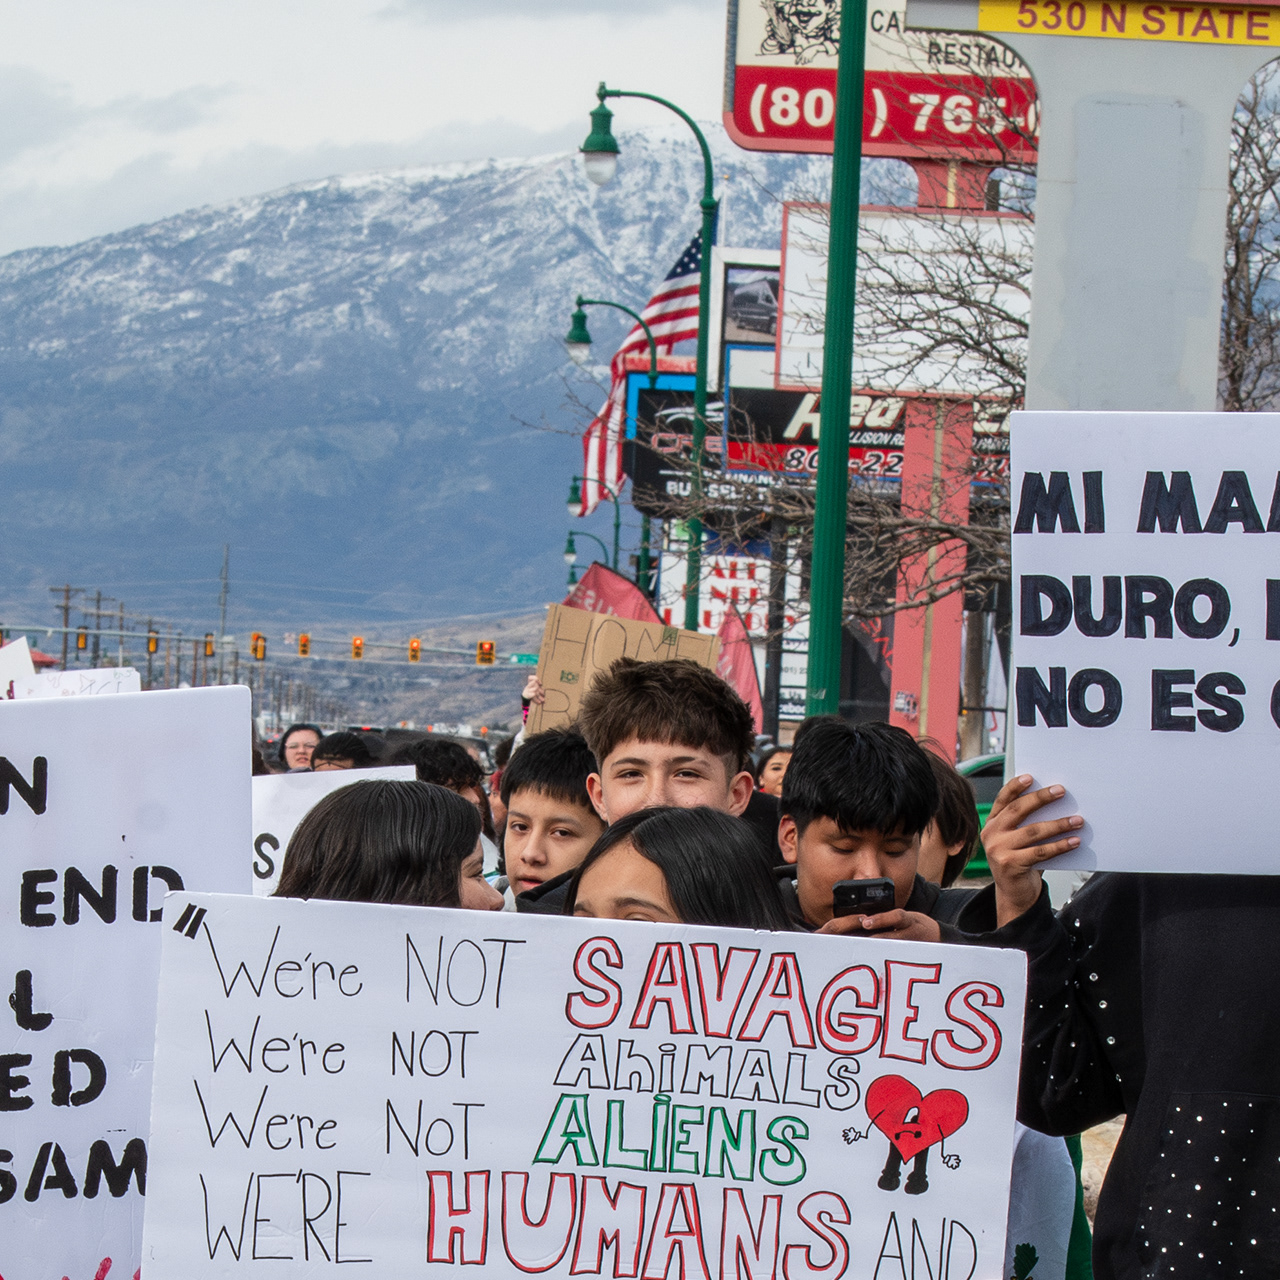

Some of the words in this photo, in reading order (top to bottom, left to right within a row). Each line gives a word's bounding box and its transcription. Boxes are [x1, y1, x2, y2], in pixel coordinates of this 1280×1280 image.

[1017, 0, 1087, 31] 530
[1101, 2, 1127, 33] N
[1141, 5, 1270, 41] STATE
[928, 41, 1026, 69] RESTAU
[750, 83, 888, 139] (80)
[1013, 470, 1106, 535] MI
[1019, 574, 1240, 648] DURO,
[1016, 666, 1123, 730] NO
[1151, 668, 1247, 733] ES
[20, 864, 186, 929] END
[406, 933, 527, 1009] NOT
[566, 934, 1005, 1071] SAVAGES
[391, 1030, 479, 1079] NOT
